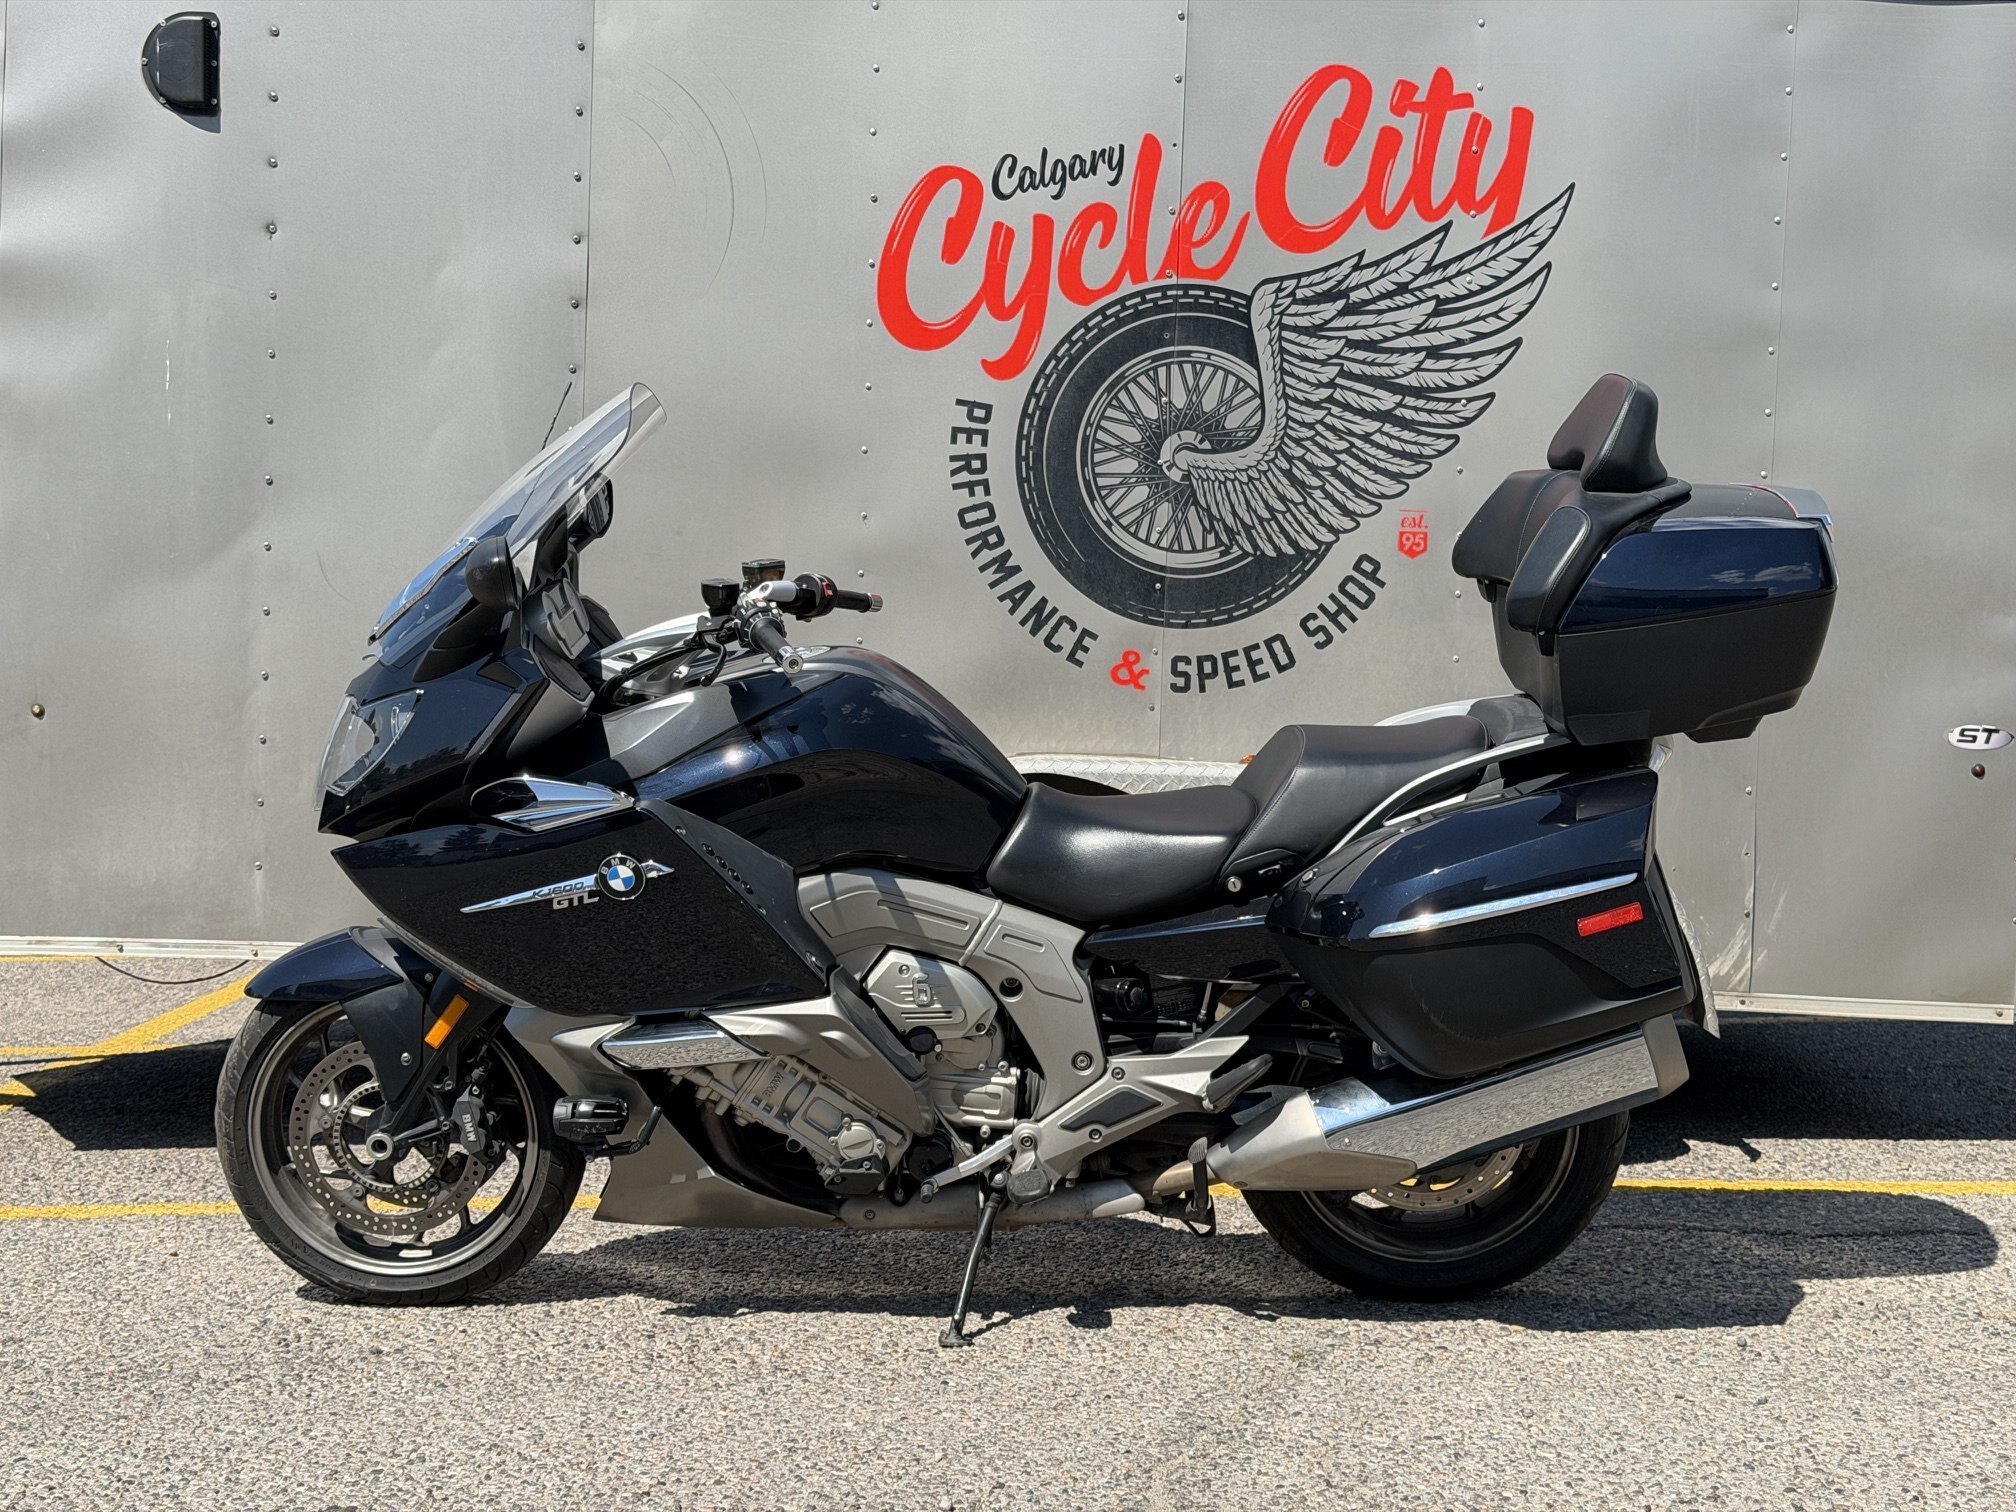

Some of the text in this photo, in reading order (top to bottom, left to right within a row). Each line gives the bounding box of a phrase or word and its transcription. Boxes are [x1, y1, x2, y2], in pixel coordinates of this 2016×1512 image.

[991, 143, 1125, 201] Calgary
[876, 63, 1535, 382] Cycle City
[949, 398, 1387, 694] PERFORMANCE & SPEED SHOP
[1401, 532, 1425, 552] 95
[600, 858, 636, 875] BMW
[552, 891, 600, 910] GTL
[462, 1113, 477, 1142] BMW
